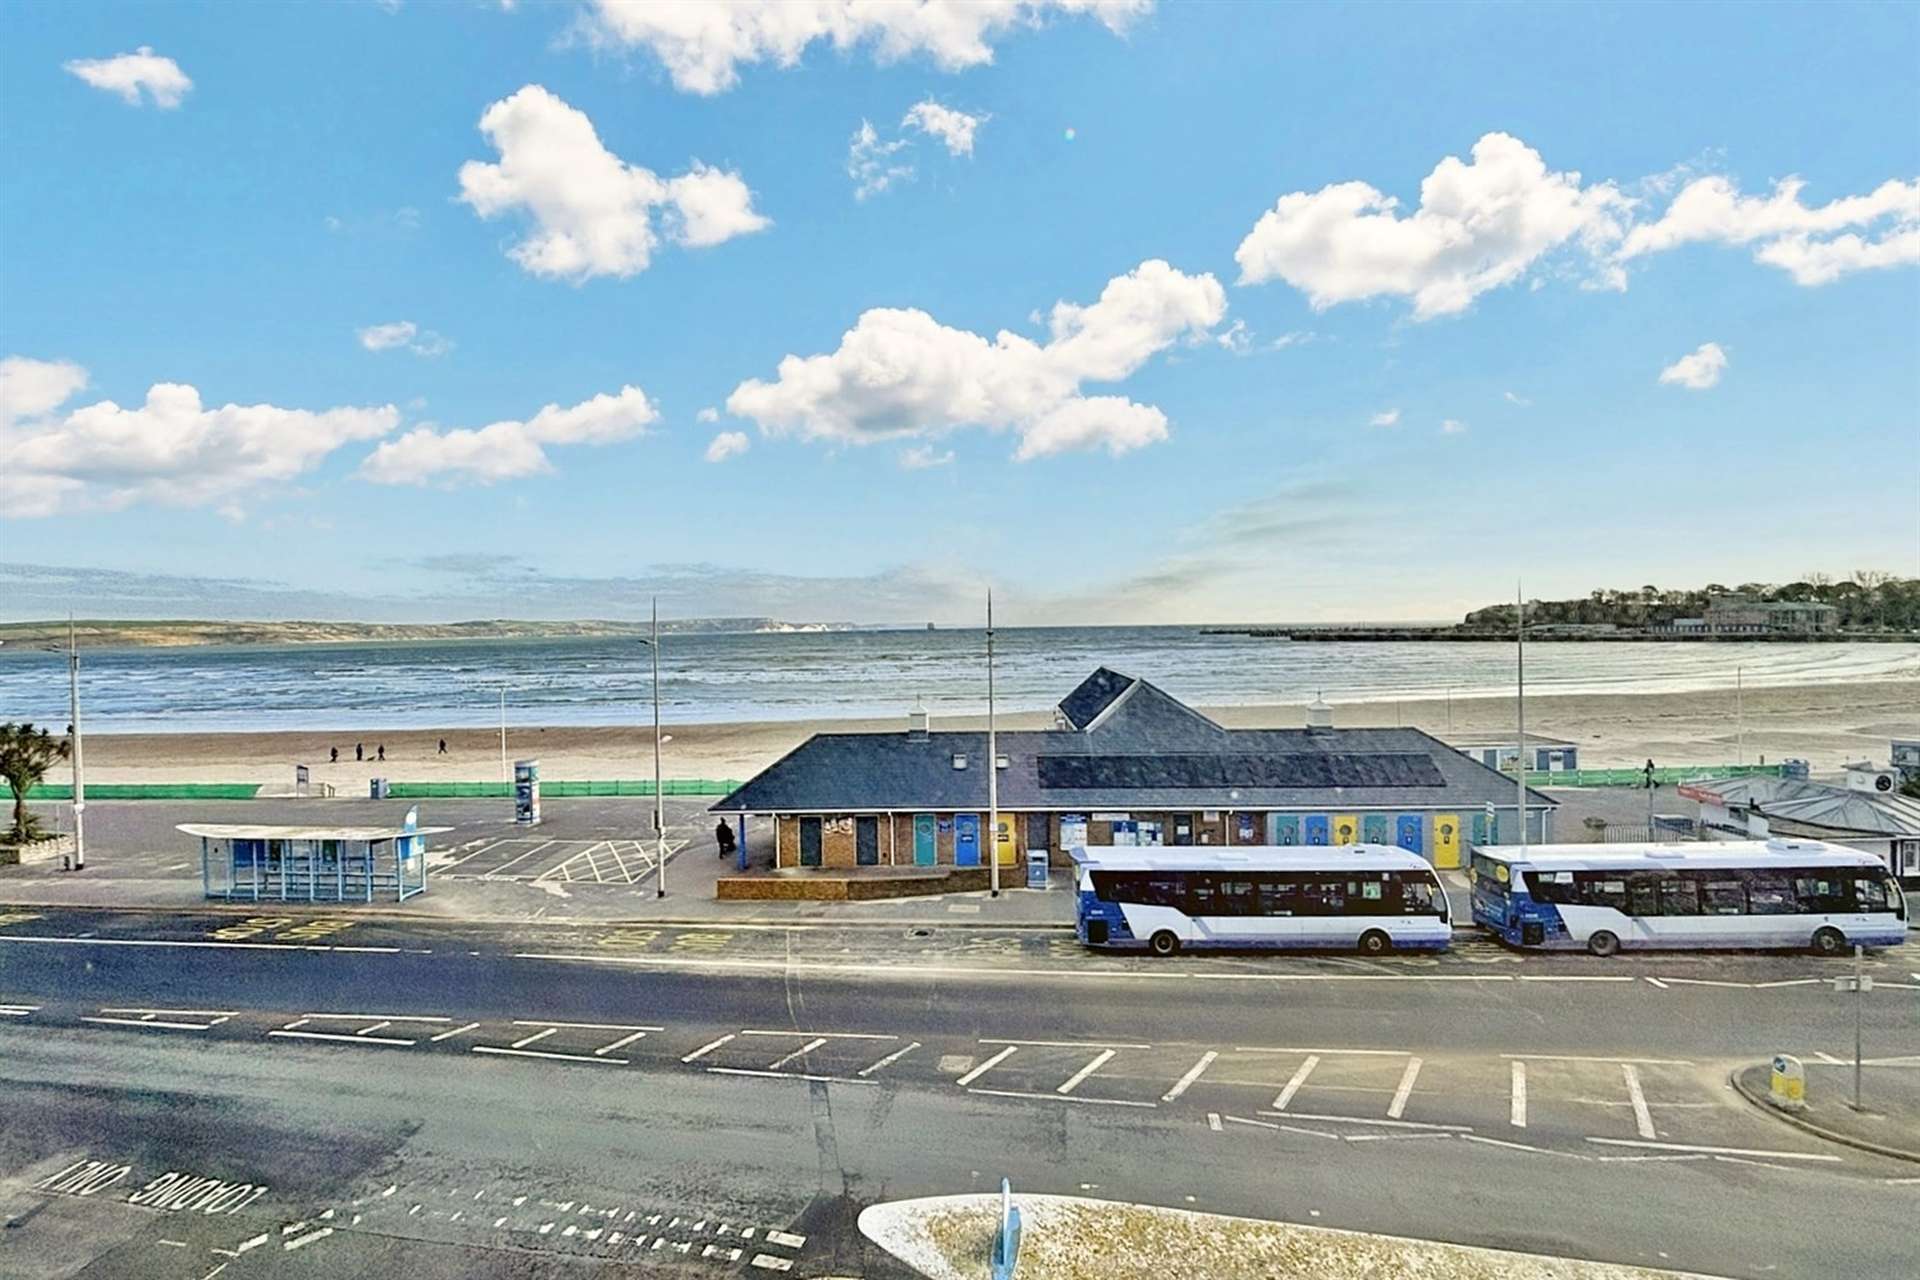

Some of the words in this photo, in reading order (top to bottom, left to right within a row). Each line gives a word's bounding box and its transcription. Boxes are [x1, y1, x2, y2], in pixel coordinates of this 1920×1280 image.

[206, 917, 294, 940] STOP
[275, 919, 356, 940] BUS
[32, 1158, 133, 1196] ONLY
[128, 1171, 269, 1215] LOADING
